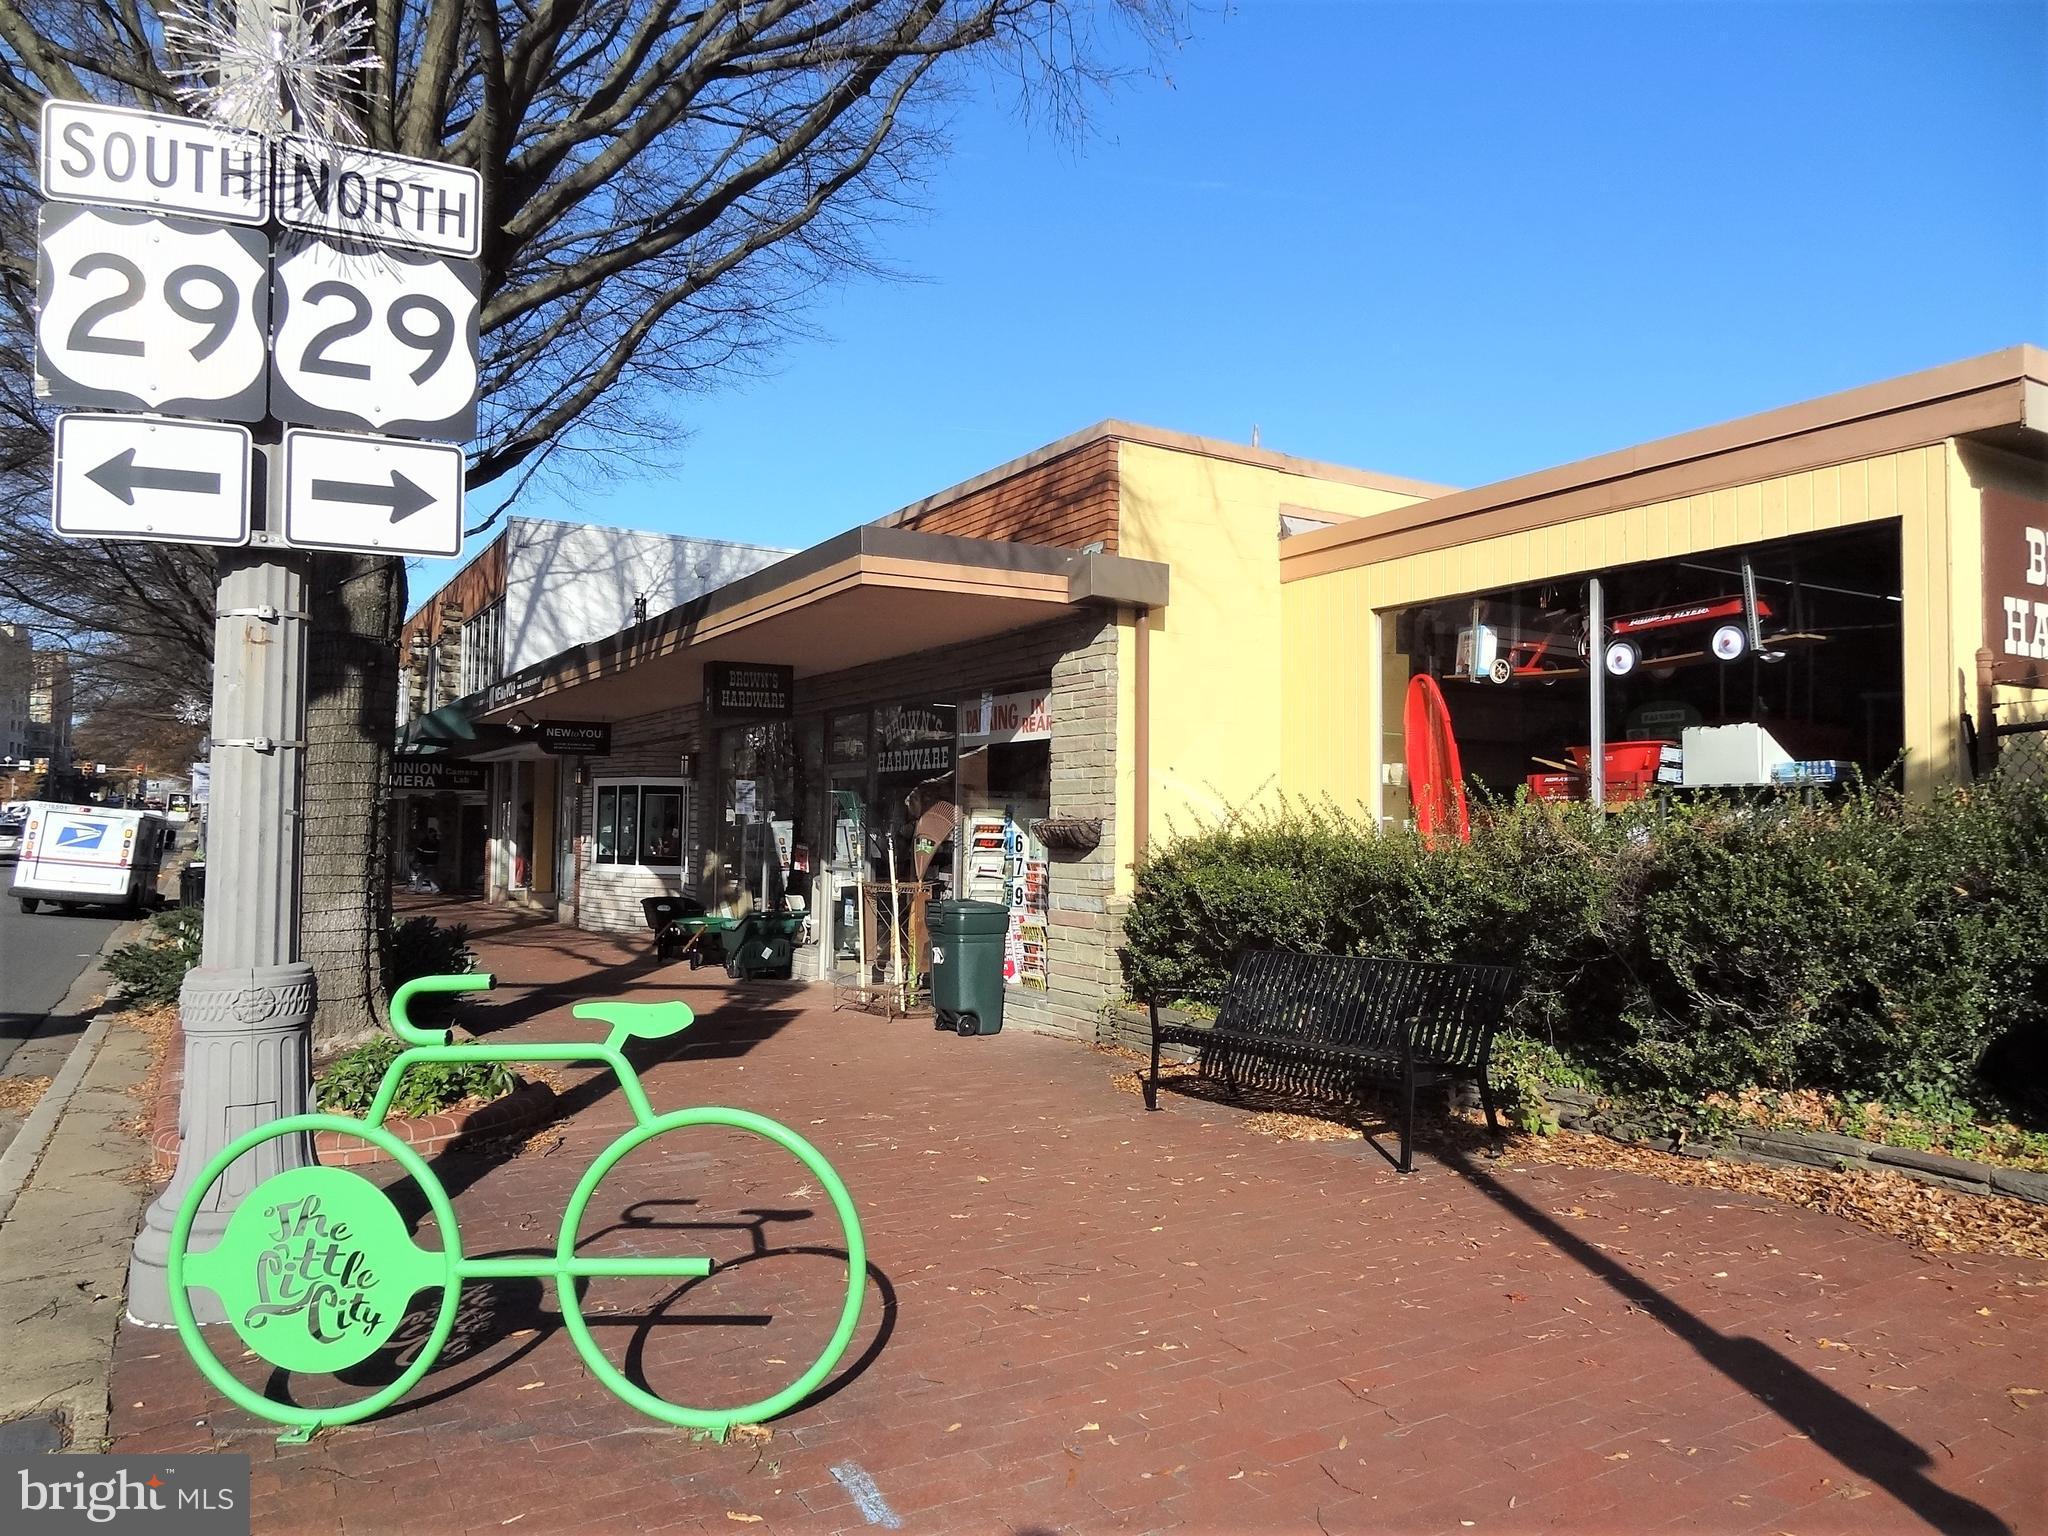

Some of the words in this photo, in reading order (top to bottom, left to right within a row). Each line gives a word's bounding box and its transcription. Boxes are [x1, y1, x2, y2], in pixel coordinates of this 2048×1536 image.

[61, 121, 255, 200] SOUTH
[294, 157, 467, 239] NORTH
[66, 251, 241, 364] 29
[299, 280, 456, 387] 29
[2025, 526, 2048, 587] B
[721, 689, 785, 709] HARDWARE
[729, 670, 779, 689] BROWN'S
[884, 709, 943, 746] BROWN'S
[966, 703, 1018, 735] PAING
[1031, 698, 1046, 716] IN
[878, 746, 949, 773] HARDWARE
[1015, 834, 1023, 853] 6
[1015, 857, 1024, 876] 7
[1015, 886, 1023, 906] 9
[263, 1194, 353, 1242] The
[244, 1238, 380, 1329] Little
[307, 1282, 385, 1344] City
